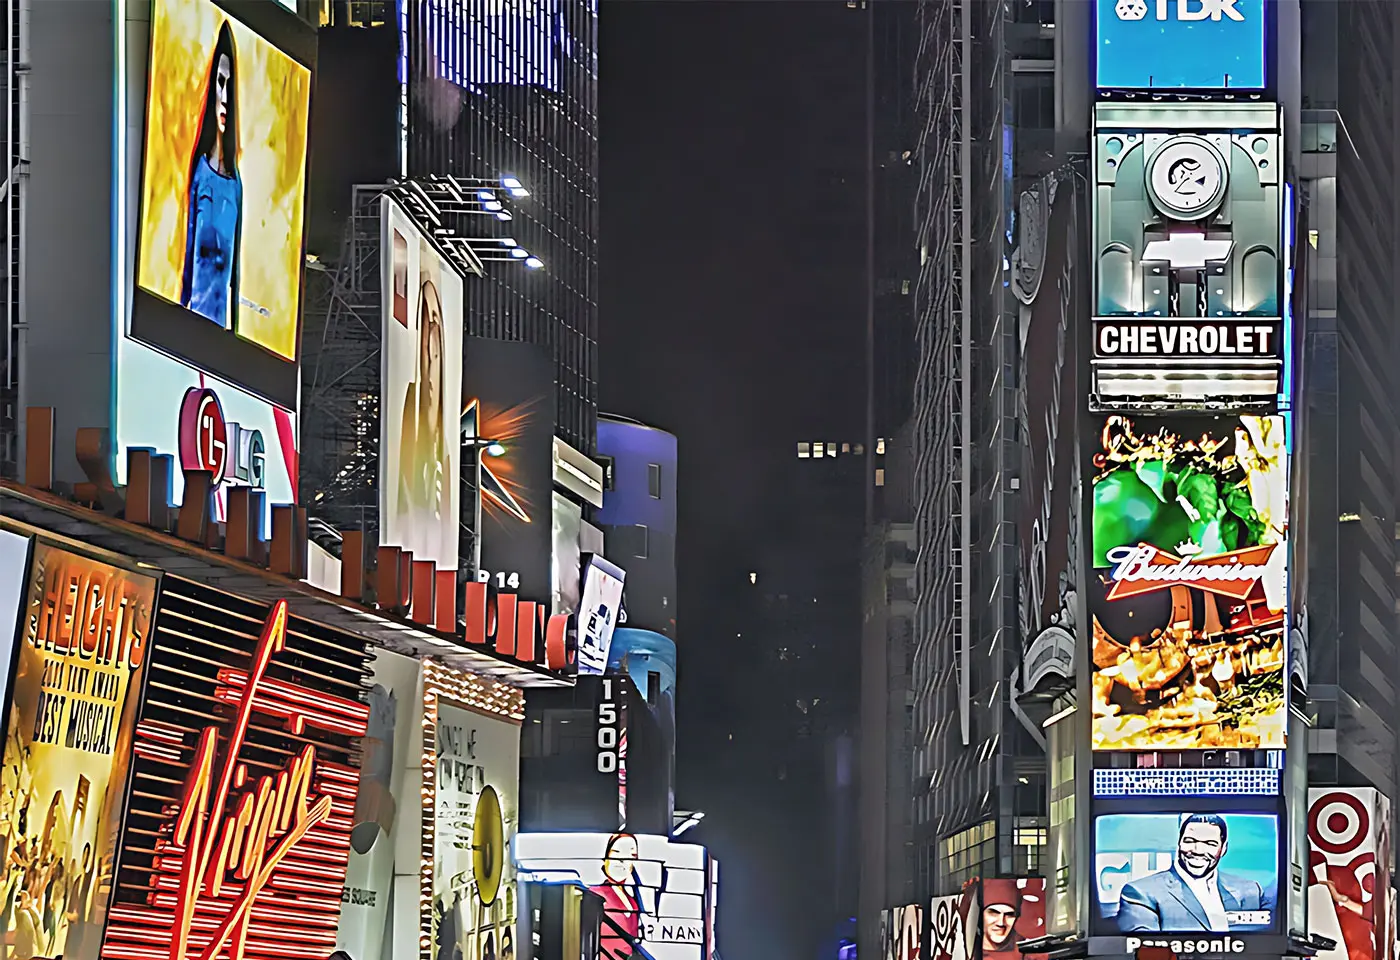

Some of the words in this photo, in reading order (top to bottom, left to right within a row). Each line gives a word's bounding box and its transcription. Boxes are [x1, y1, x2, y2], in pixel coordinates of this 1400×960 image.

[1099, 325, 1273, 354] CHEVROLET
[225, 420, 267, 489] LG
[496, 571, 520, 589] 14
[35, 567, 149, 671] HEIGHTS
[65, 699, 116, 755] MUSICAL
[597, 678, 617, 773] 1500
